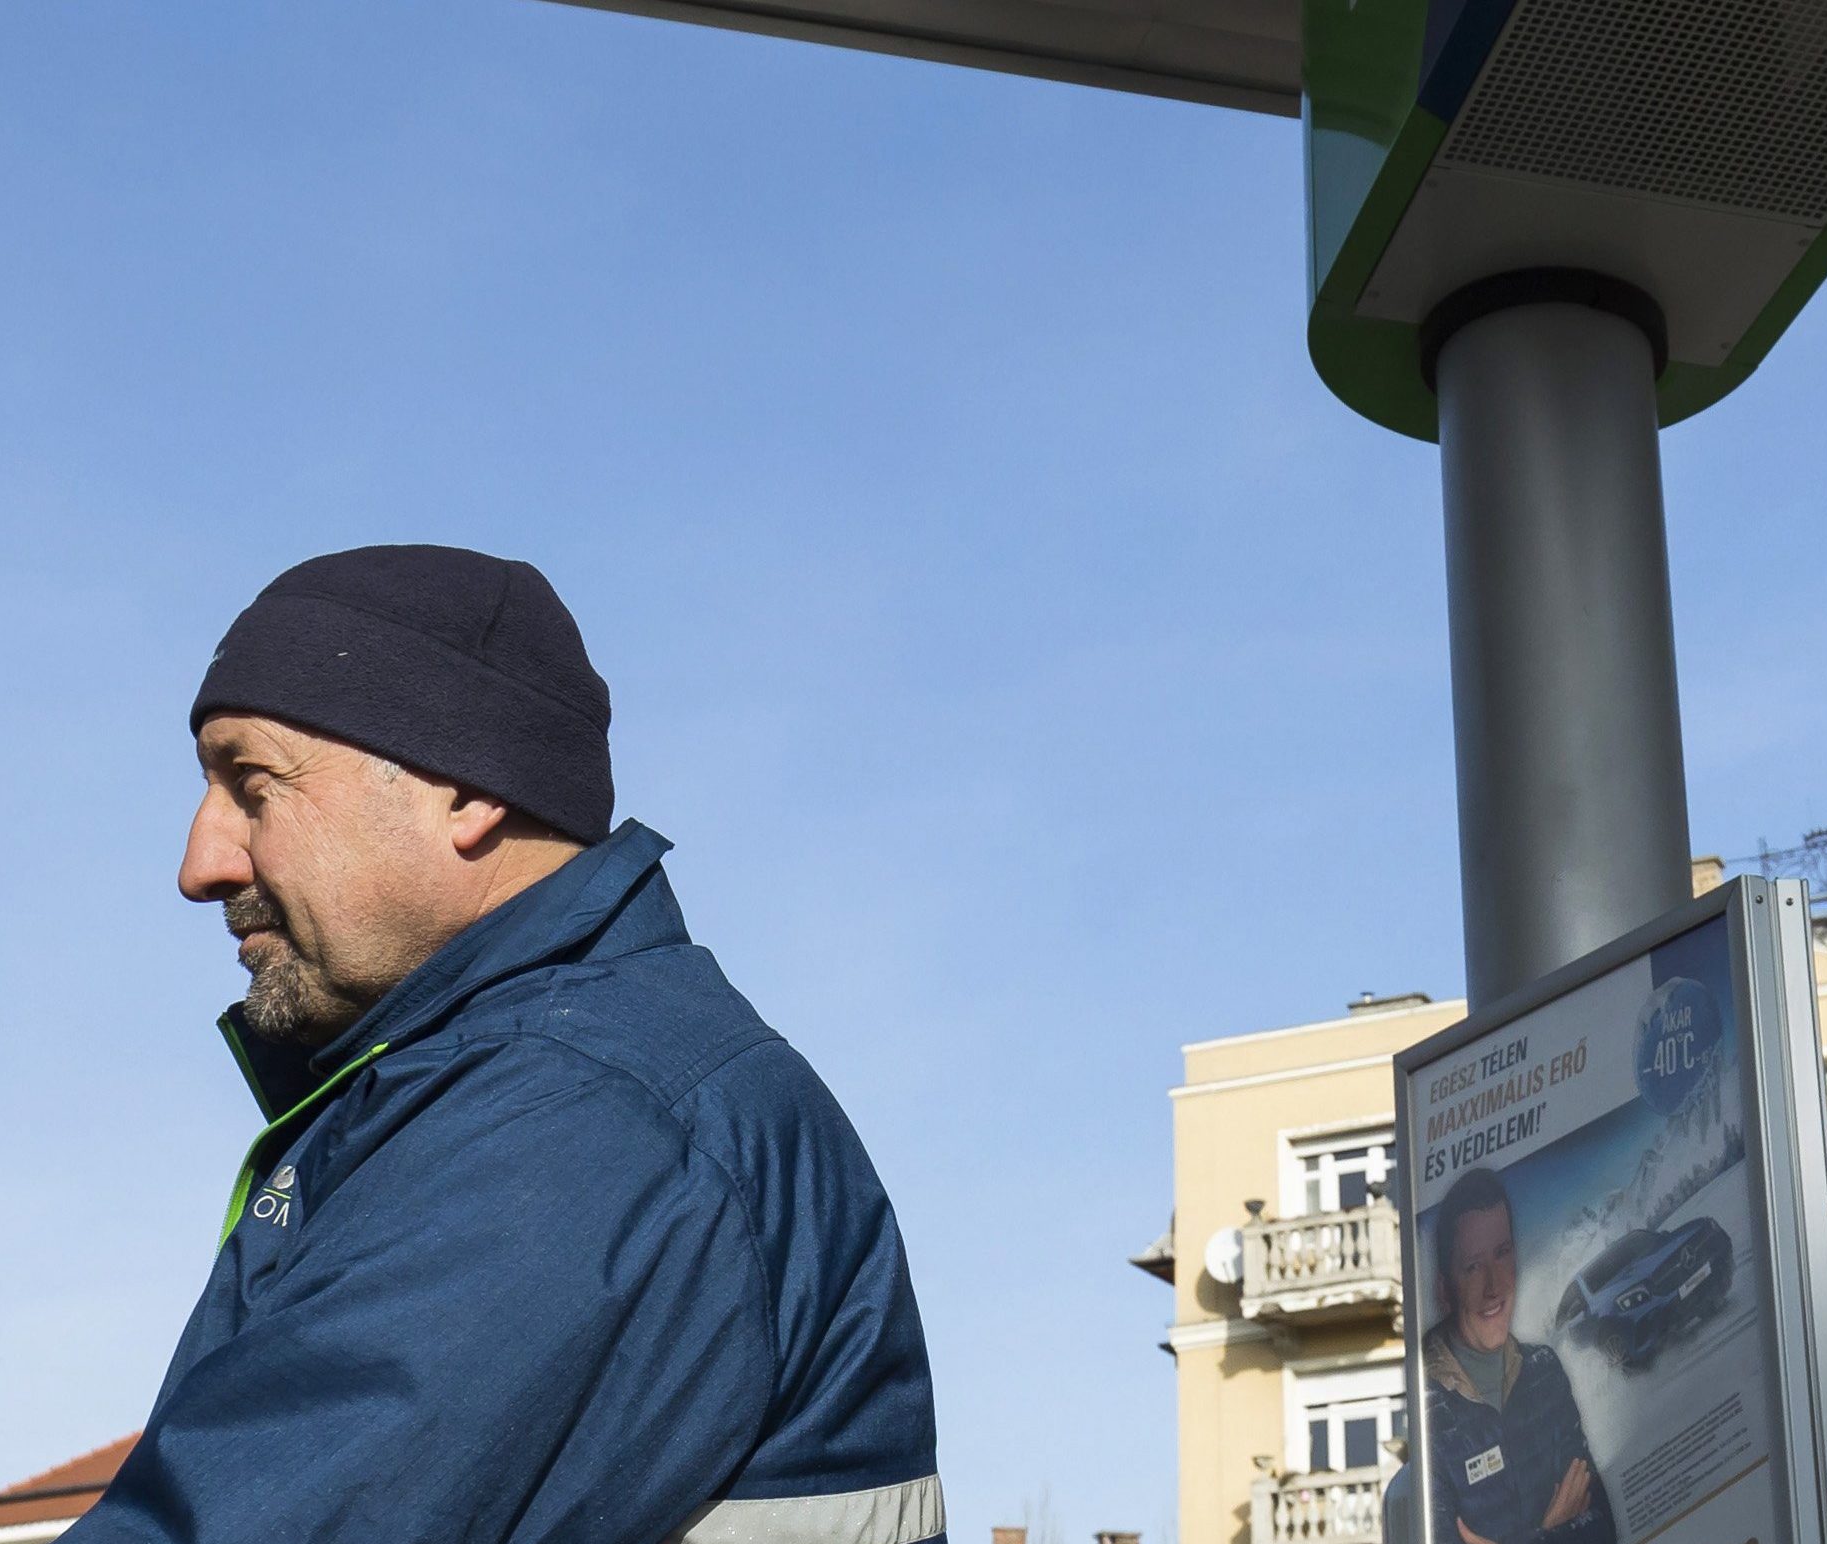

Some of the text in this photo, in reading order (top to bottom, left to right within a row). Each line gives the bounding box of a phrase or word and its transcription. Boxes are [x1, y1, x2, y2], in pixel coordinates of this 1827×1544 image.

[1427, 1036, 1588, 1144] MAXXIMÁLIS ERŐ
[1430, 1037, 1529, 1105] EGÉSZ TÉLEN
[1424, 1150, 1446, 1184] ÉS
